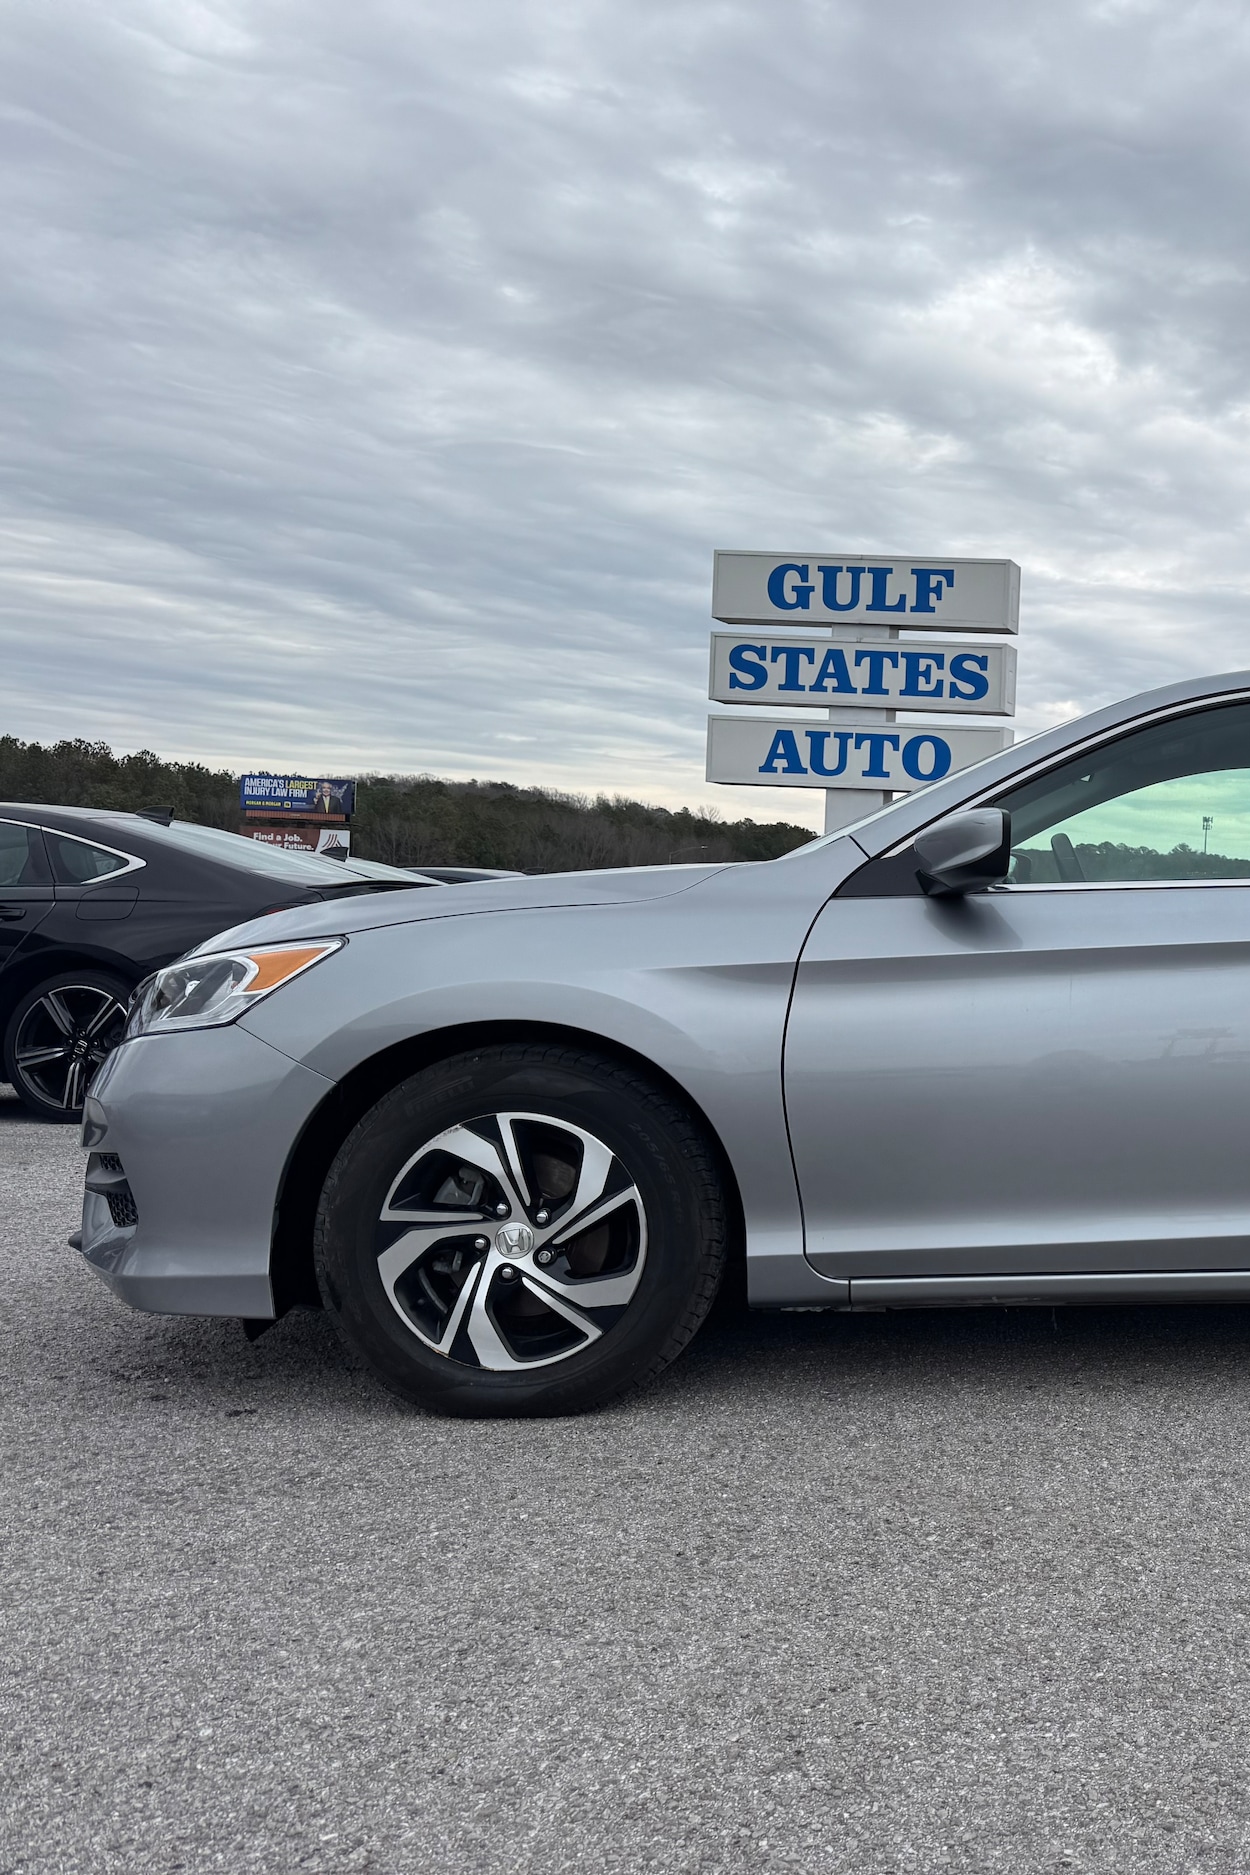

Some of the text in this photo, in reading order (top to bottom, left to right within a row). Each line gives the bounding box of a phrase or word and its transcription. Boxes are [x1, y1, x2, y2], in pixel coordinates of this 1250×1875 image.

[767, 563, 955, 613] GULF
[728, 644, 990, 702] STATES
[758, 729, 952, 782] AUTO
[244, 786, 307, 798] INJURY LAW FIRM
[245, 778, 318, 790] AMERICA'S LARGEST
[253, 832, 274, 840] Find
[284, 833, 303, 842] Job.
[284, 841, 314, 850] Future.
[627, 1122, 676, 1185] 205/65
